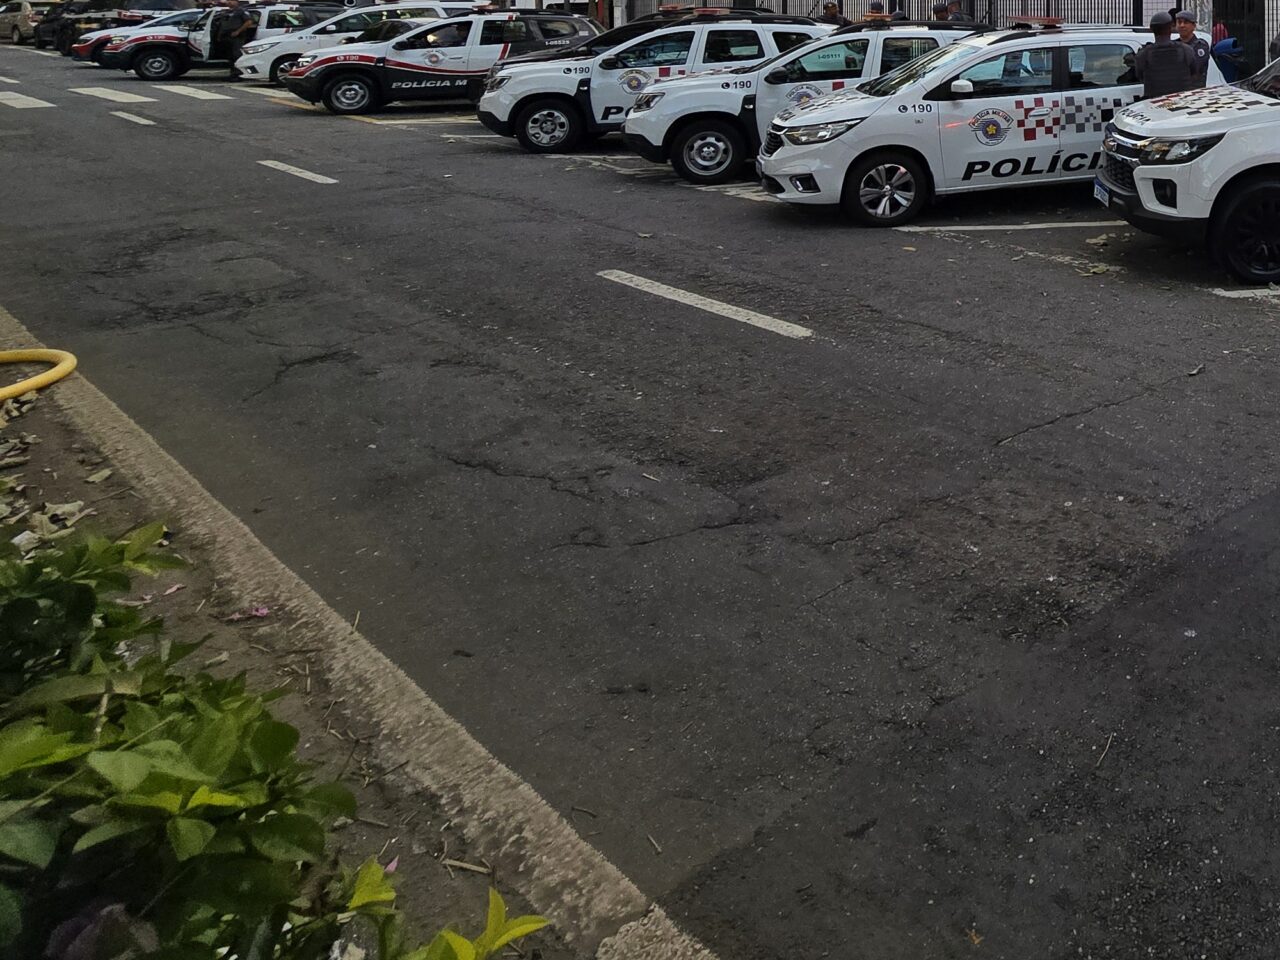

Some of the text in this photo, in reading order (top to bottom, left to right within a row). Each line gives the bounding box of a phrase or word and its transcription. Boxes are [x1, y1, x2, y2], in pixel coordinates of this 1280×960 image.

[573, 66, 590, 74] 190
[391, 79, 451, 89] POLÍCIA
[732, 80, 752, 89] 190
[911, 103, 932, 113] 190
[961, 150, 1103, 181] POLÍCI
